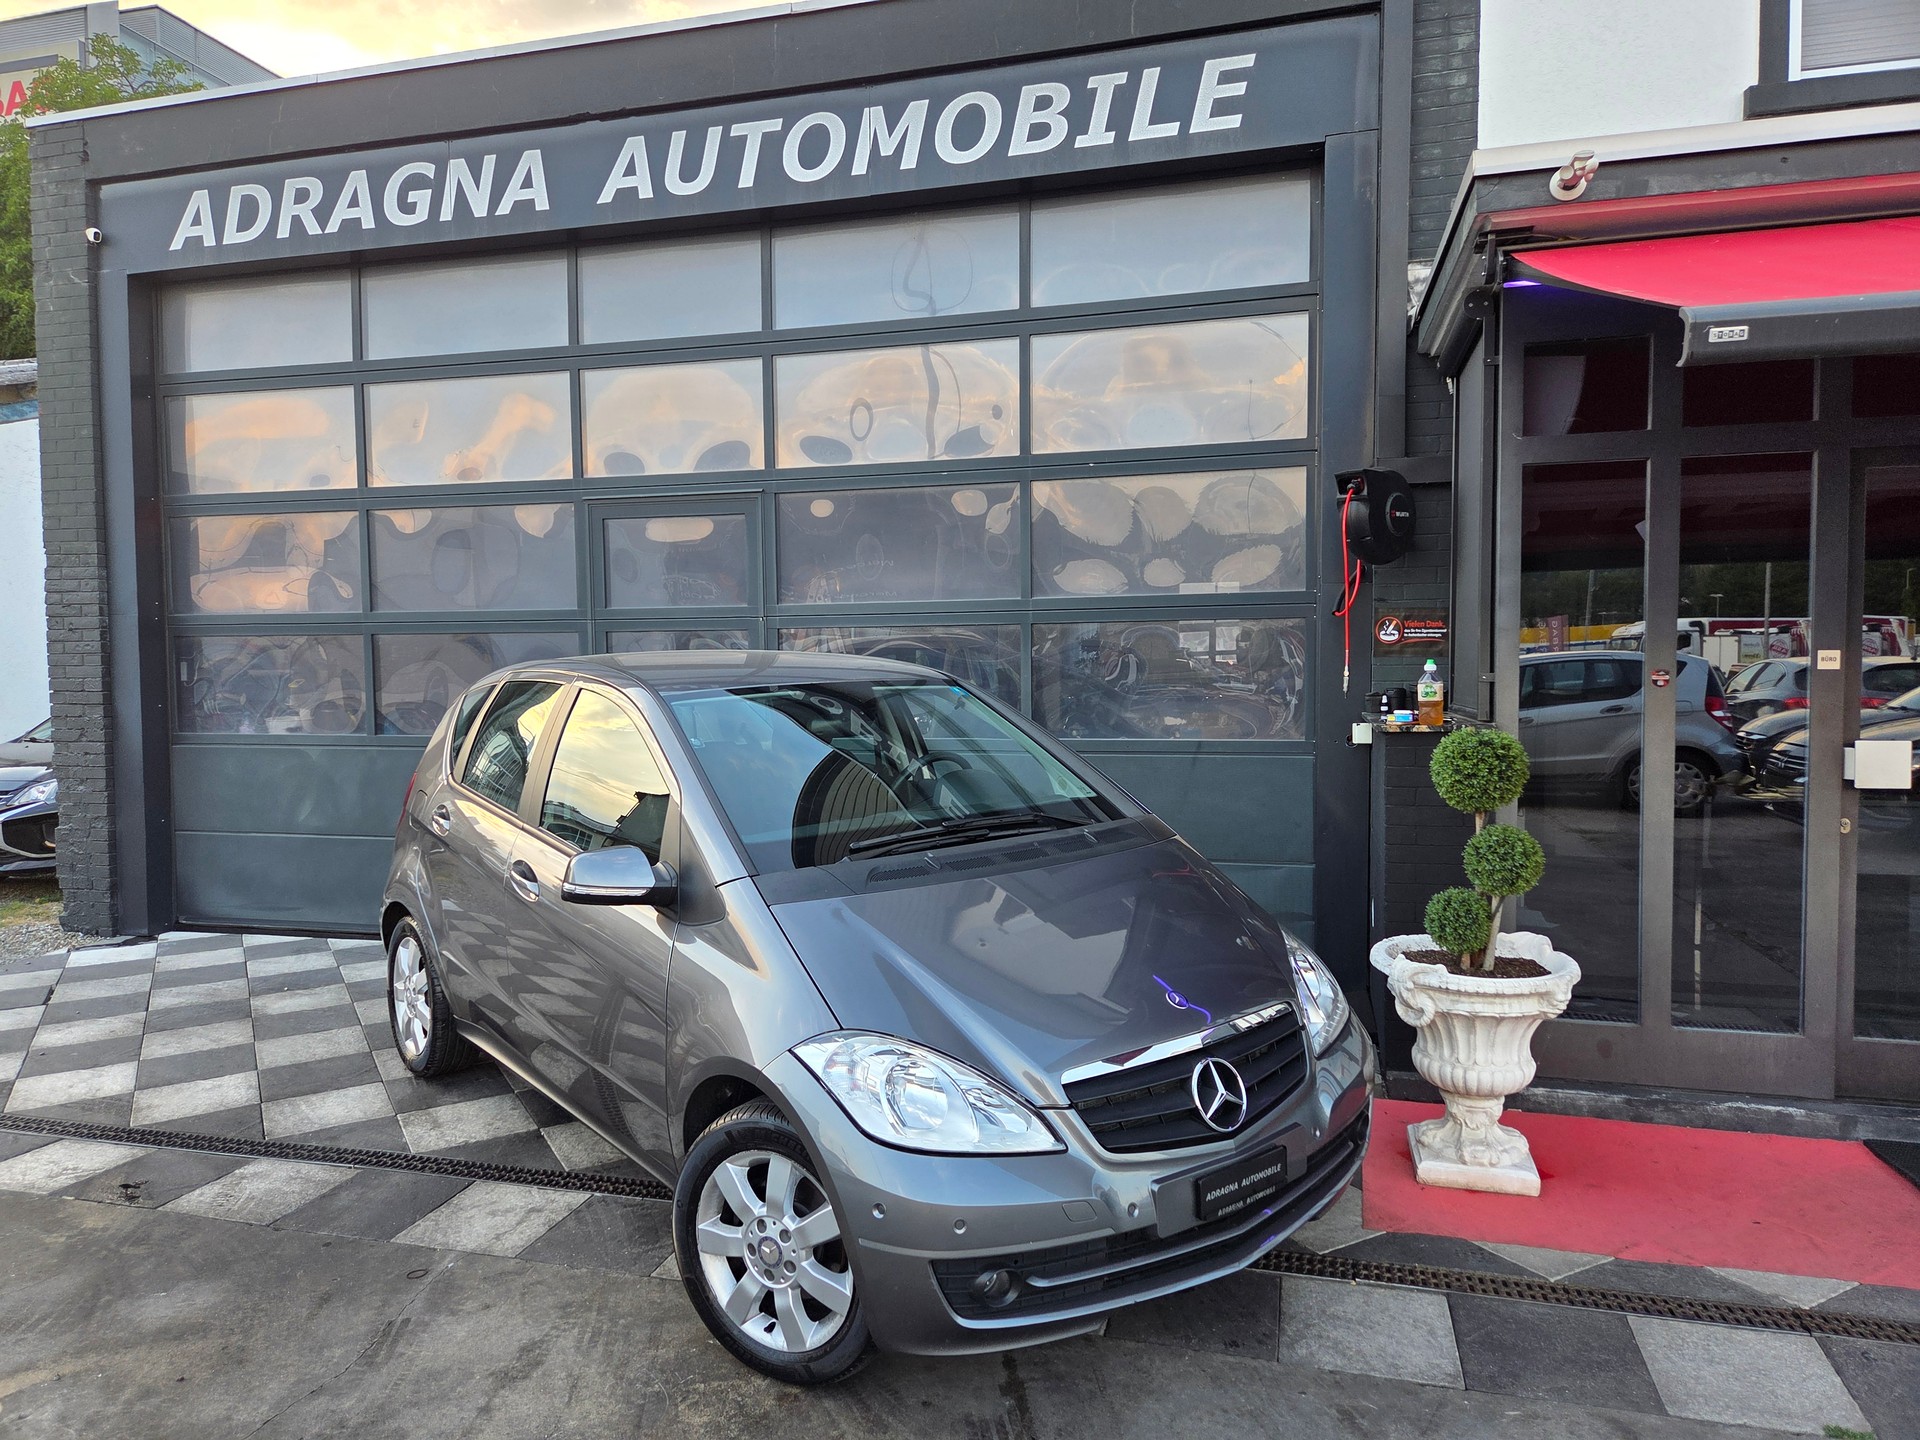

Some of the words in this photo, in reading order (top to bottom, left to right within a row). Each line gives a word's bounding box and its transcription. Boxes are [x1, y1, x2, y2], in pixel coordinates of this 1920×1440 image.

[169, 149, 550, 251] ADRAGNA
[596, 53, 1257, 204] AUTOMOBILE
[1404, 620, 1425, 628] Vielen
[1206, 1181, 1239, 1202] ADRAGNA
[1241, 1163, 1282, 1187] AUTOMOBILE
